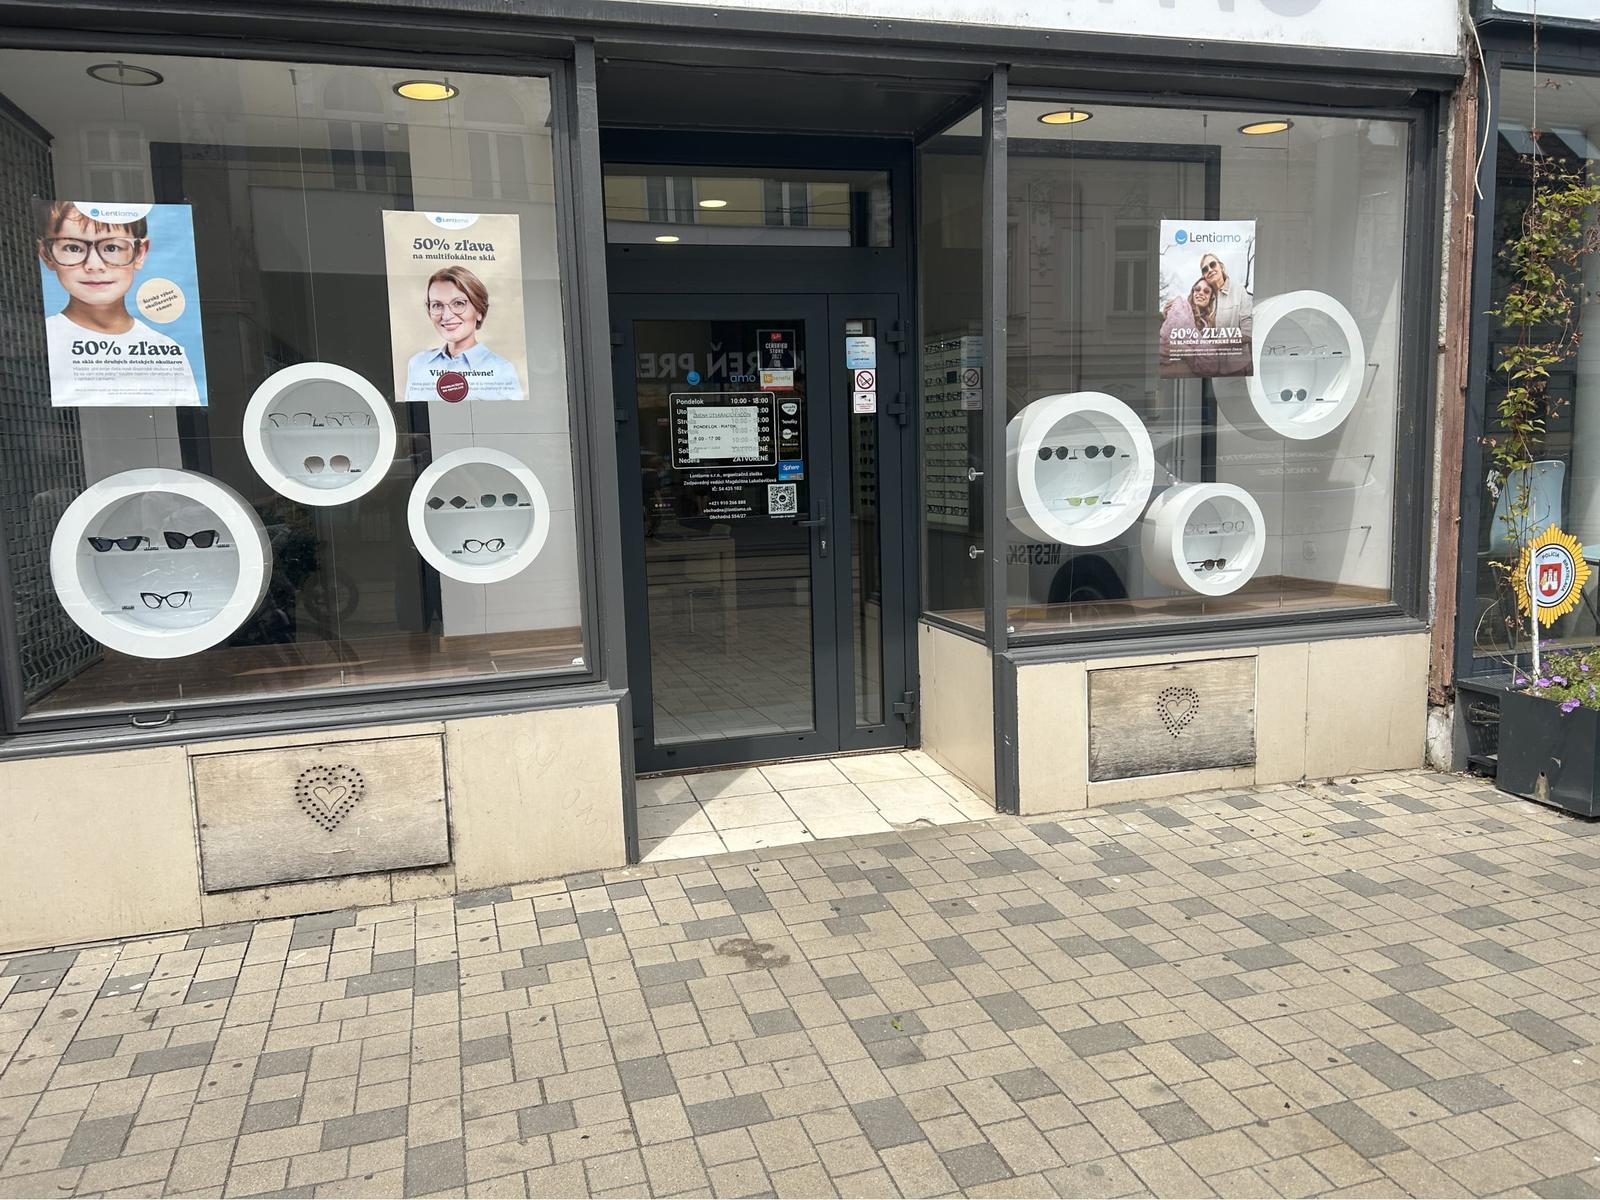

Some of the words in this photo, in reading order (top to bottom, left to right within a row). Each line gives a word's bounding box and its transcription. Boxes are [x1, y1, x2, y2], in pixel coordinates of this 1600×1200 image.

[1190, 232, 1241, 243] Lentiamo
[413, 238, 450, 250] 50%
[454, 239, 494, 252] zľava
[1170, 328, 1199, 339] 50%
[71, 340, 122, 356] 50%
[128, 341, 183, 356] zľava
